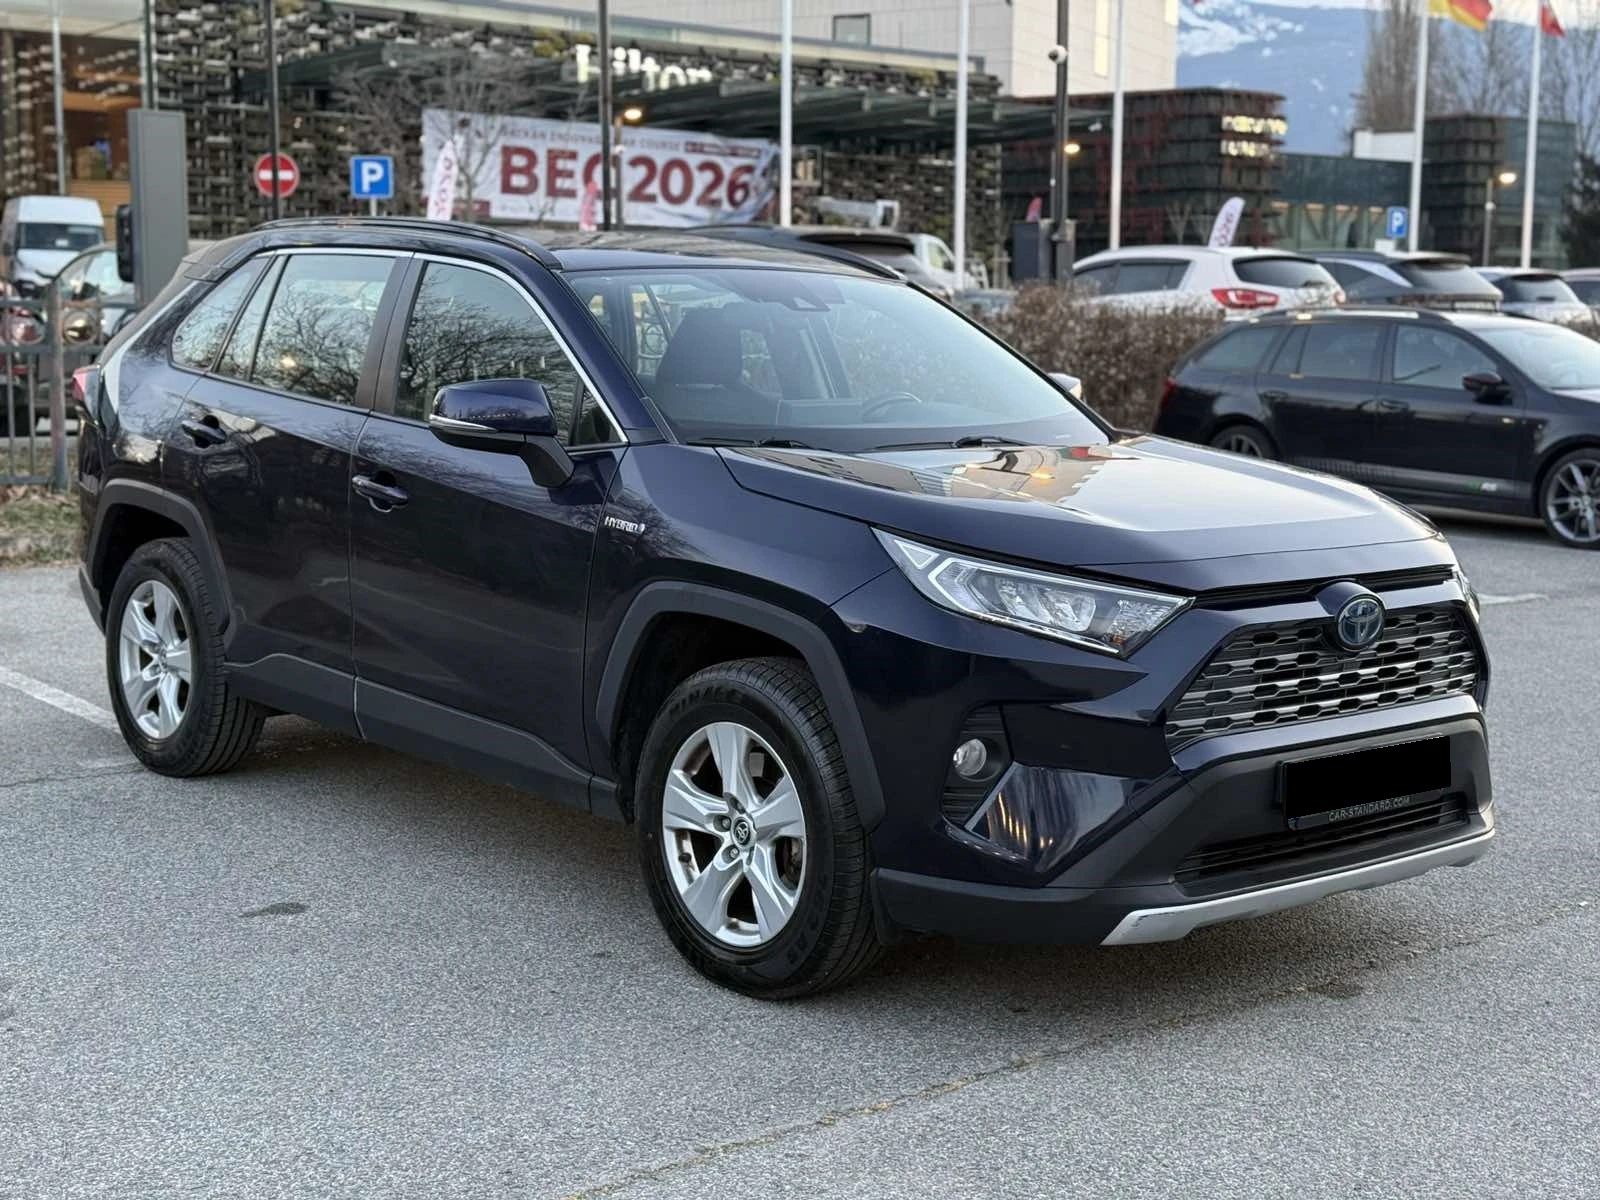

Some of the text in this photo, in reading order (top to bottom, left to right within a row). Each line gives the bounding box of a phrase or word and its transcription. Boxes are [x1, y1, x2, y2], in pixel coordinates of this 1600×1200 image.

[361, 161, 384, 193] P
[1391, 211, 1404, 233] P
[604, 515, 639, 533] HYBRID
[1328, 796, 1410, 822] CAR-STANDARD.COM
